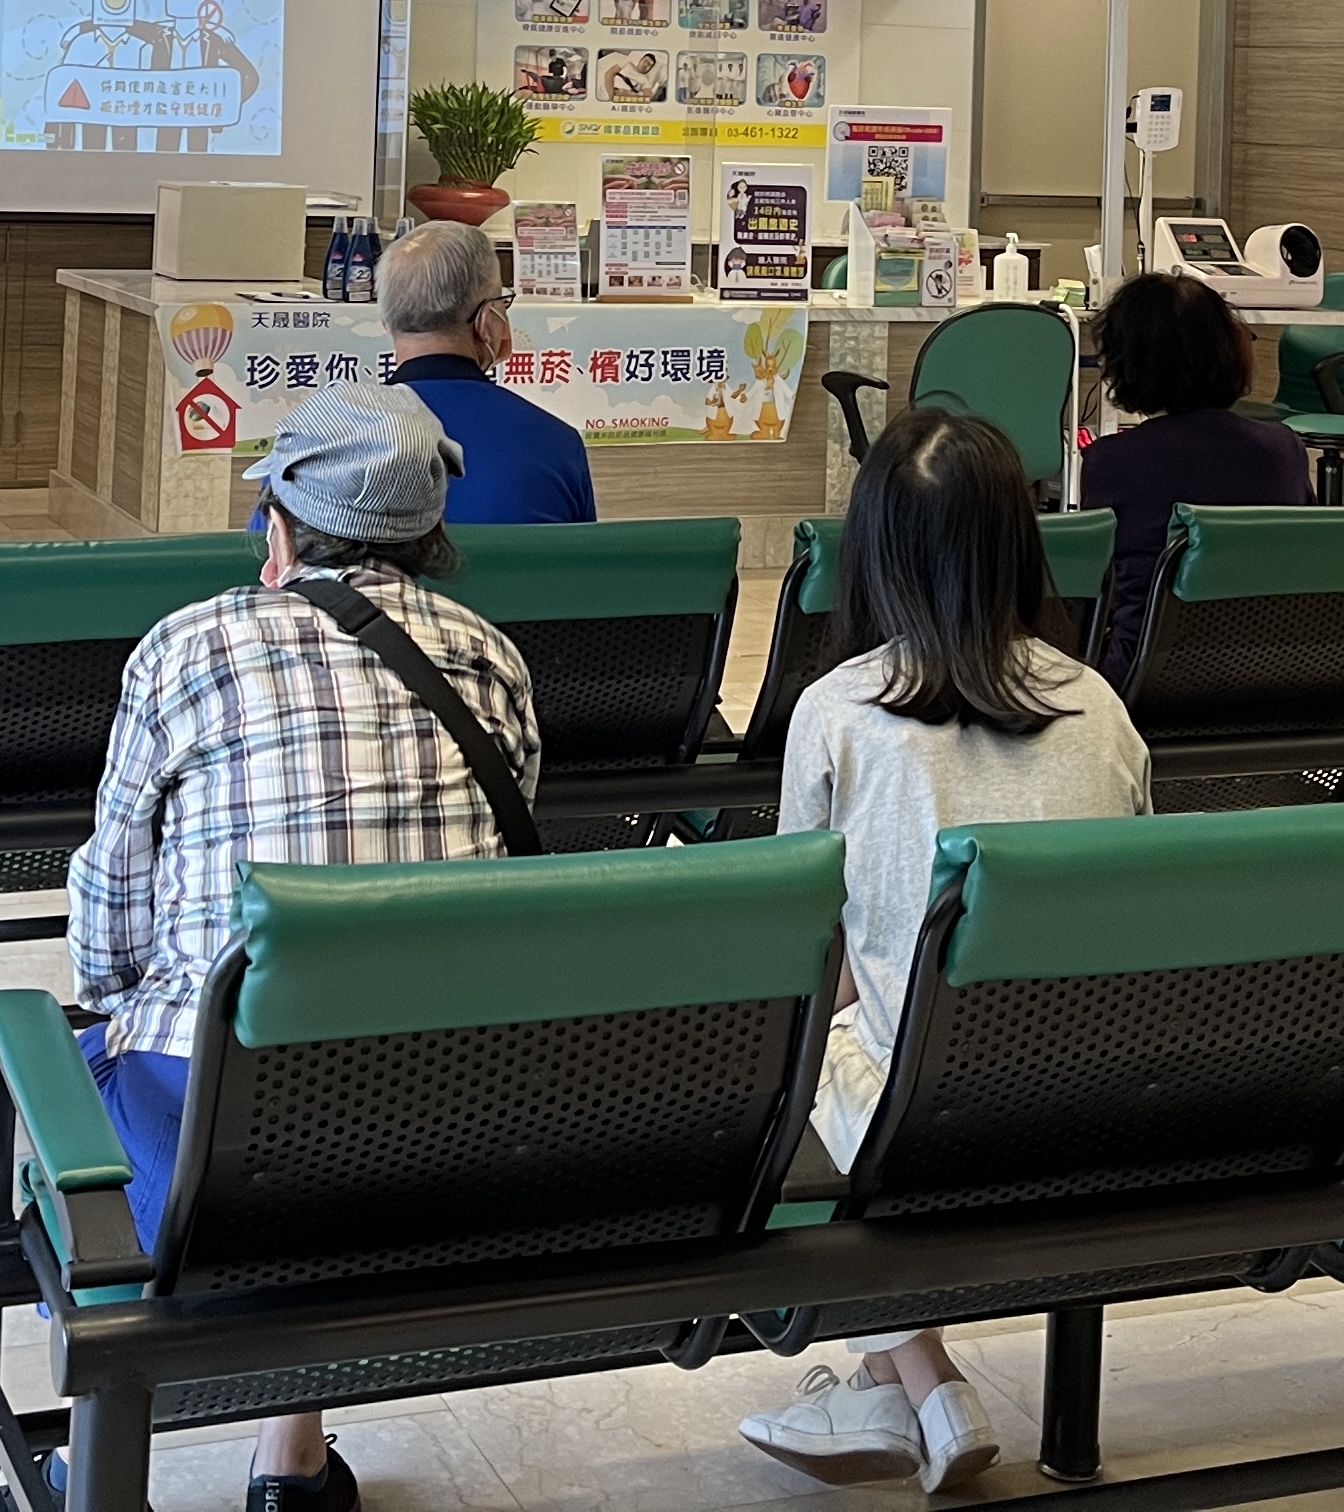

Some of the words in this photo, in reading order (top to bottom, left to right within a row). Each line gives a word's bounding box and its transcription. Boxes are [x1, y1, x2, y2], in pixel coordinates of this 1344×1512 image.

[726, 125, 800, 140] 03-461-1322
[250, 311, 331, 329] 天晟醫院
[489, 348, 727, 385] 無菸、檳好環境
[585, 418, 606, 430] NO
[611, 416, 670, 429] SMOKING
